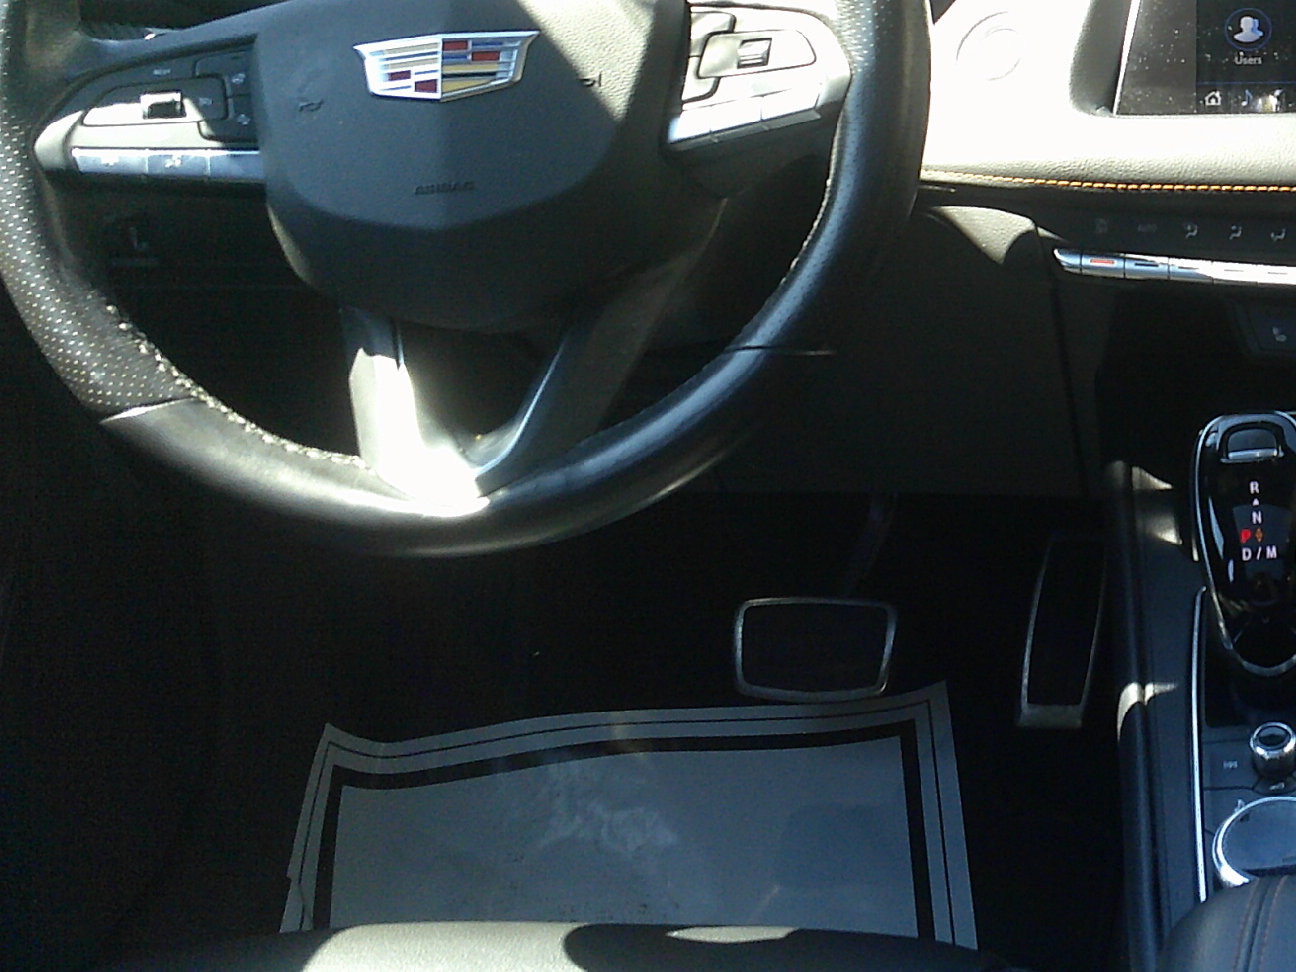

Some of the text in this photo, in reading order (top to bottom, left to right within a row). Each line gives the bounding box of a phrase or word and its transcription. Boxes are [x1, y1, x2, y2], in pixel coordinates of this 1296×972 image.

[1234, 55, 1262, 65] Users
[1249, 481, 1260, 494] R
[1252, 511, 1262, 524] N
[1241, 529, 1252, 543] P
